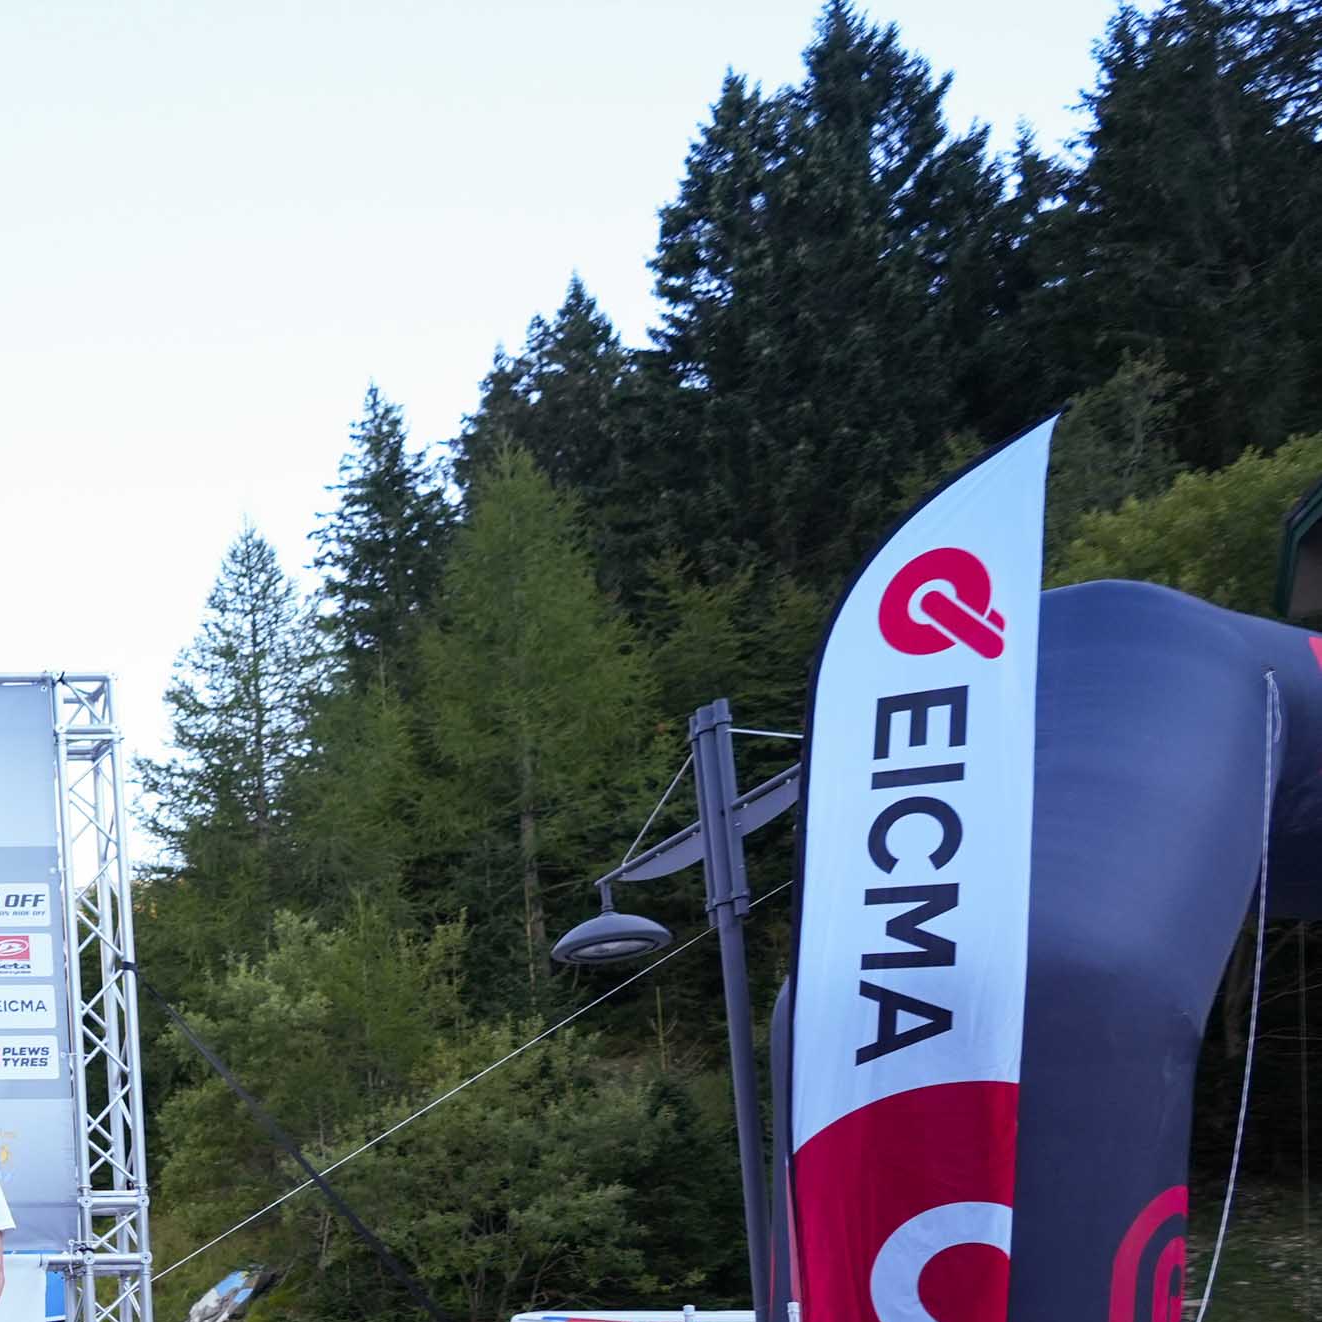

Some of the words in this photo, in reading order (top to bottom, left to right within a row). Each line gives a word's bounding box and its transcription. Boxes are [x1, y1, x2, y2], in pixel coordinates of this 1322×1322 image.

[855, 685, 970, 1066] EICMA
[4, 893, 45, 907] OFF
[2, 1046, 50, 1057] PLEWS
[2, 1057, 49, 1067] TYRES
